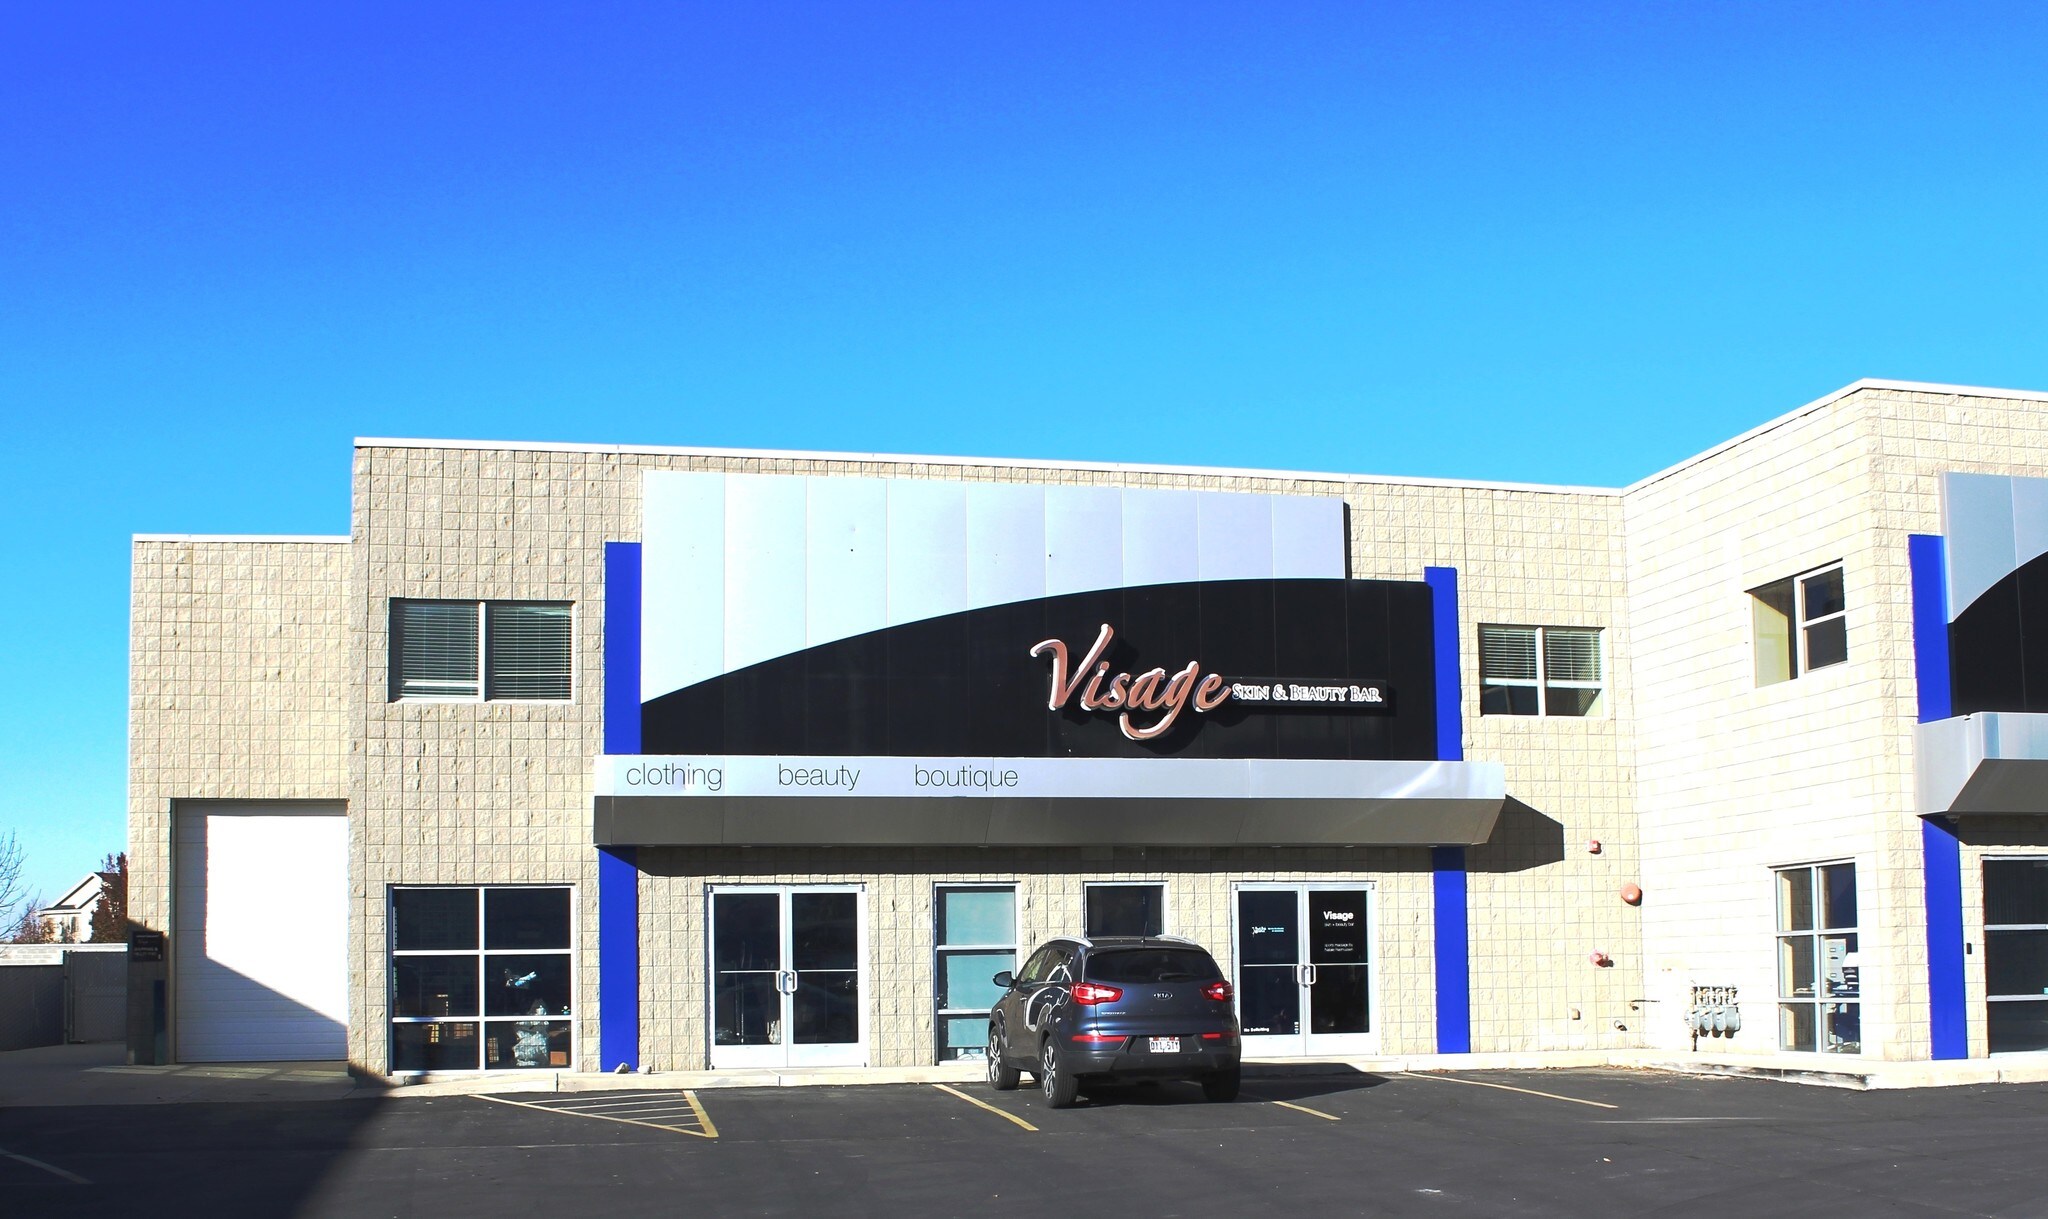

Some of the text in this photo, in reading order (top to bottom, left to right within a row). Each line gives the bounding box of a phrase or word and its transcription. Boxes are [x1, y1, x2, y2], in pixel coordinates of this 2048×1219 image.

[1029, 622, 1383, 741] Visage SKIN & BEAUTY BAR
[626, 762, 1019, 792] clothing beauty boutique
[1323, 910, 1354, 922] Visage
